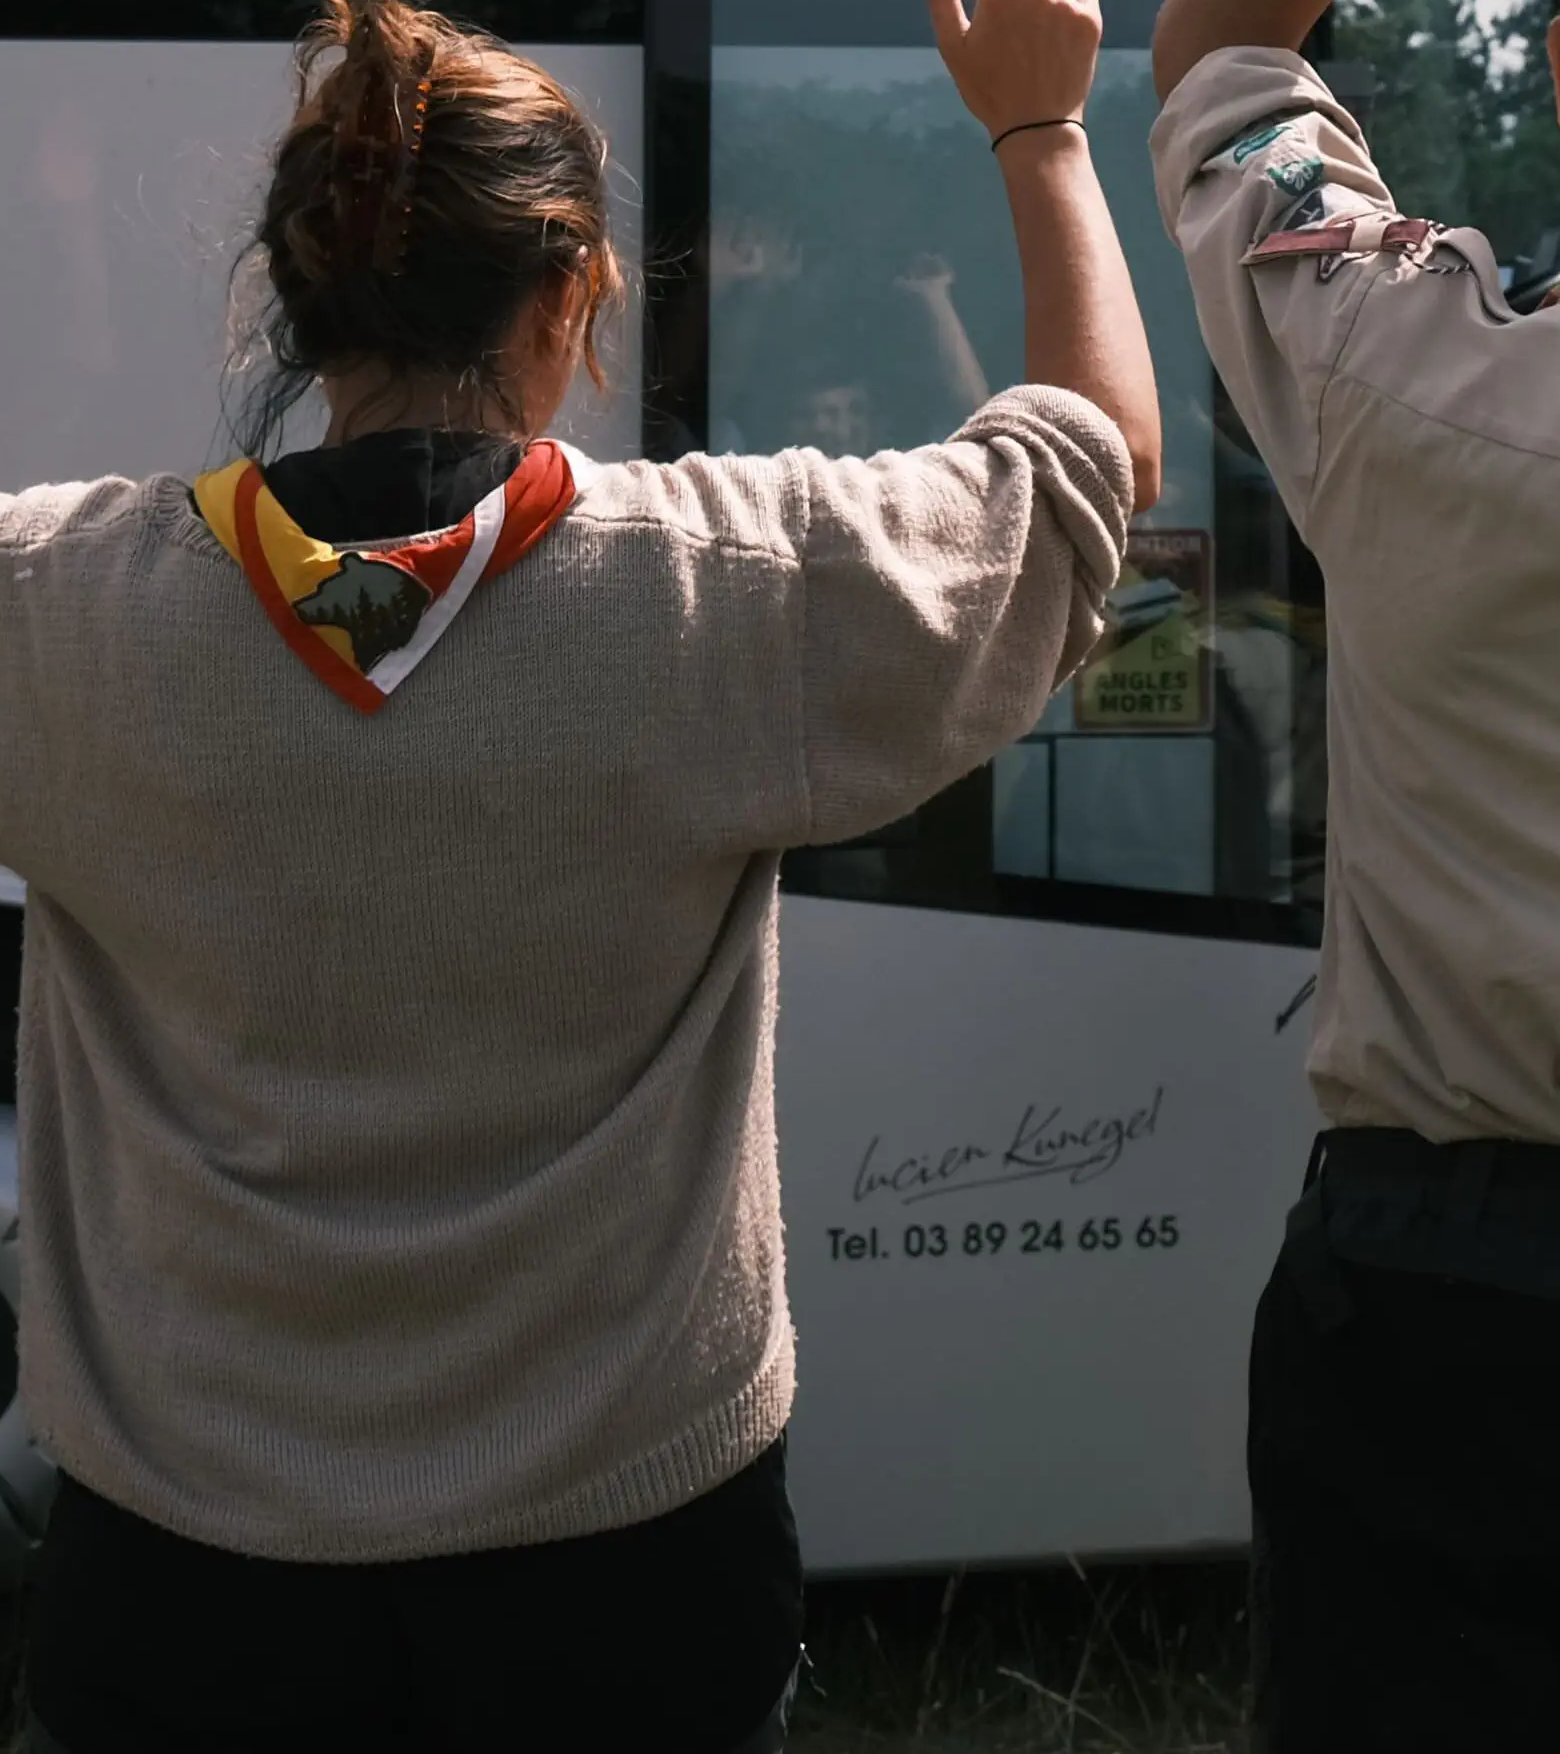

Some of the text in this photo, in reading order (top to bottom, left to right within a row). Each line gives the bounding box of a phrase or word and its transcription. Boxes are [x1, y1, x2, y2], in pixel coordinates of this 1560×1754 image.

[1096, 671, 1188, 691] ANGLES
[1099, 693, 1184, 713] MORTS
[1002, 1085, 1163, 1185] Kunegel
[827, 1213, 1181, 1261] Tel. 03 89 24 65 65
